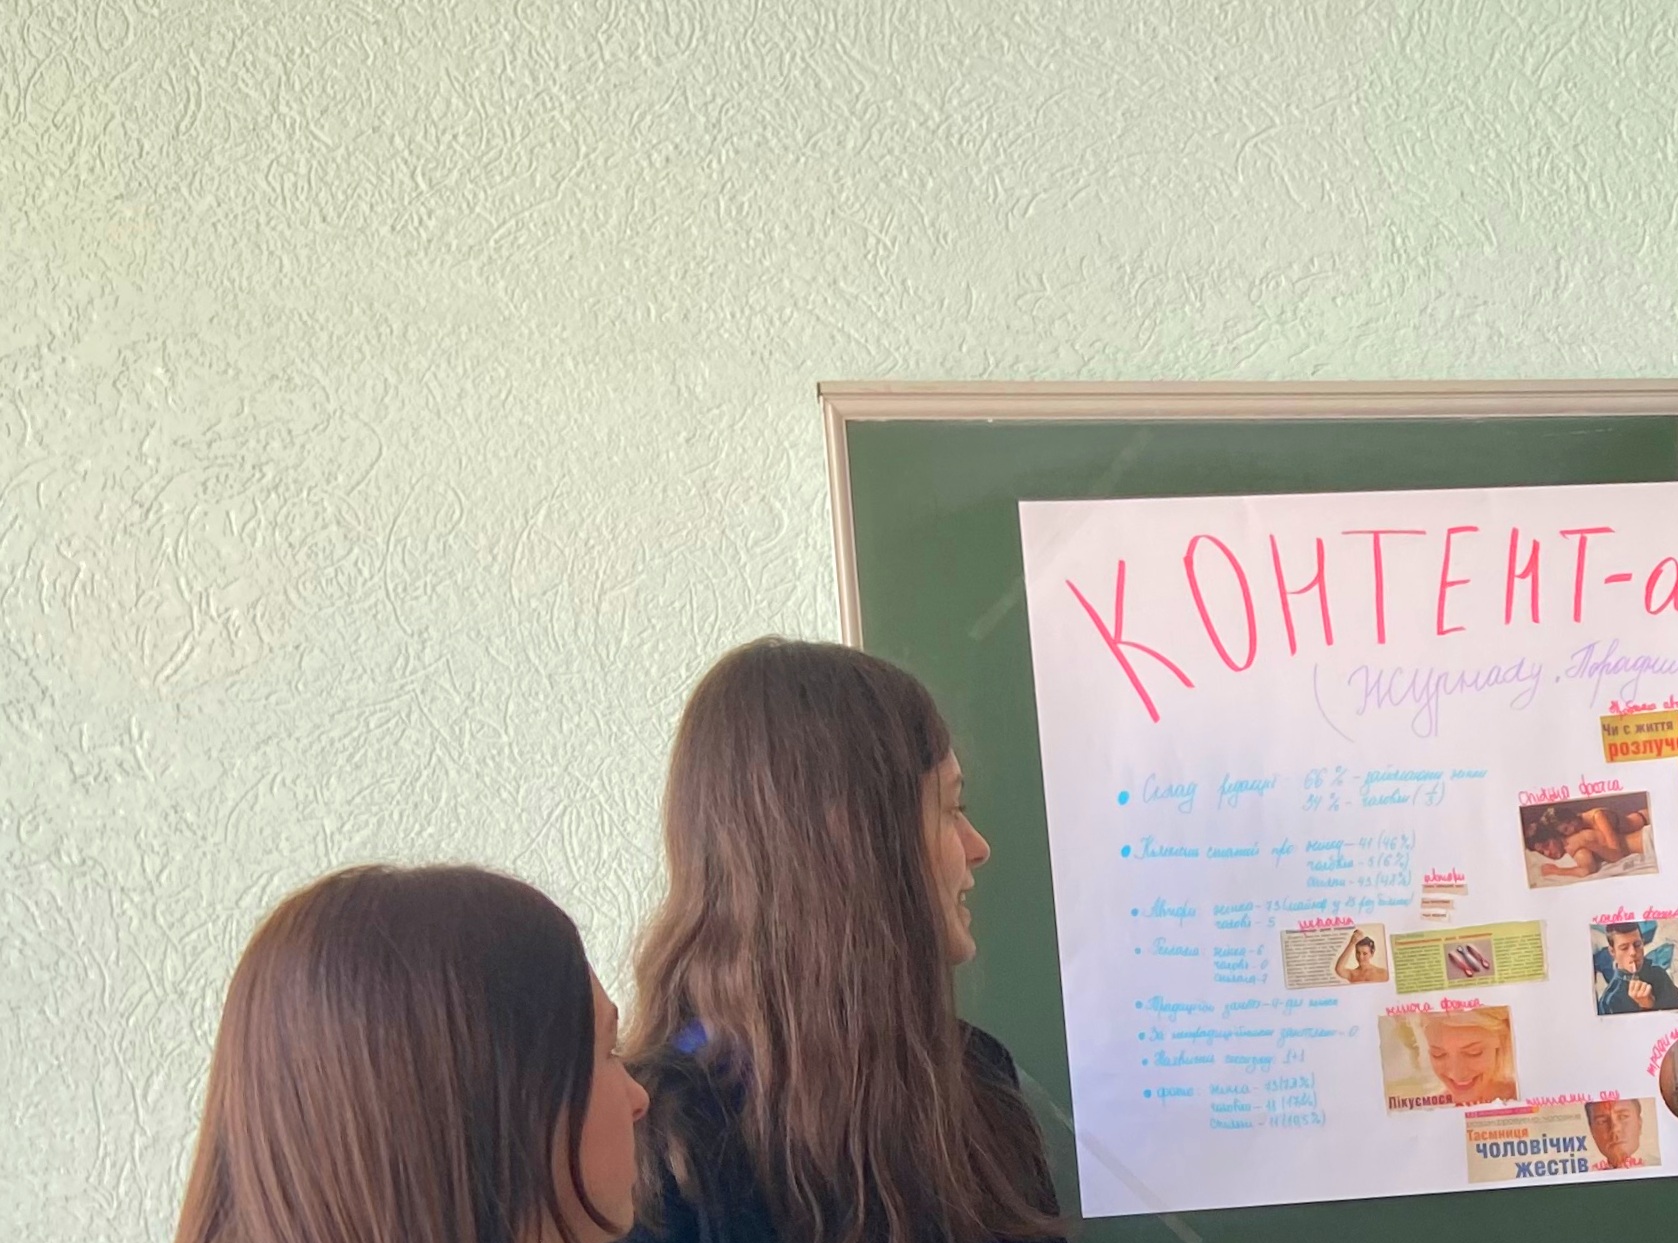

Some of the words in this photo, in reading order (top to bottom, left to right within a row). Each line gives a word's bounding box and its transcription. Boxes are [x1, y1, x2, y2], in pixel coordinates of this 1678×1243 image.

[1602, 723, 1619, 736] Чи
[1635, 720, 1674, 734] життя
[1466, 1128, 1529, 1141] Таємниця
[1475, 1132, 1588, 1159] чоловічих
[1514, 1153, 1589, 1179] жестів
